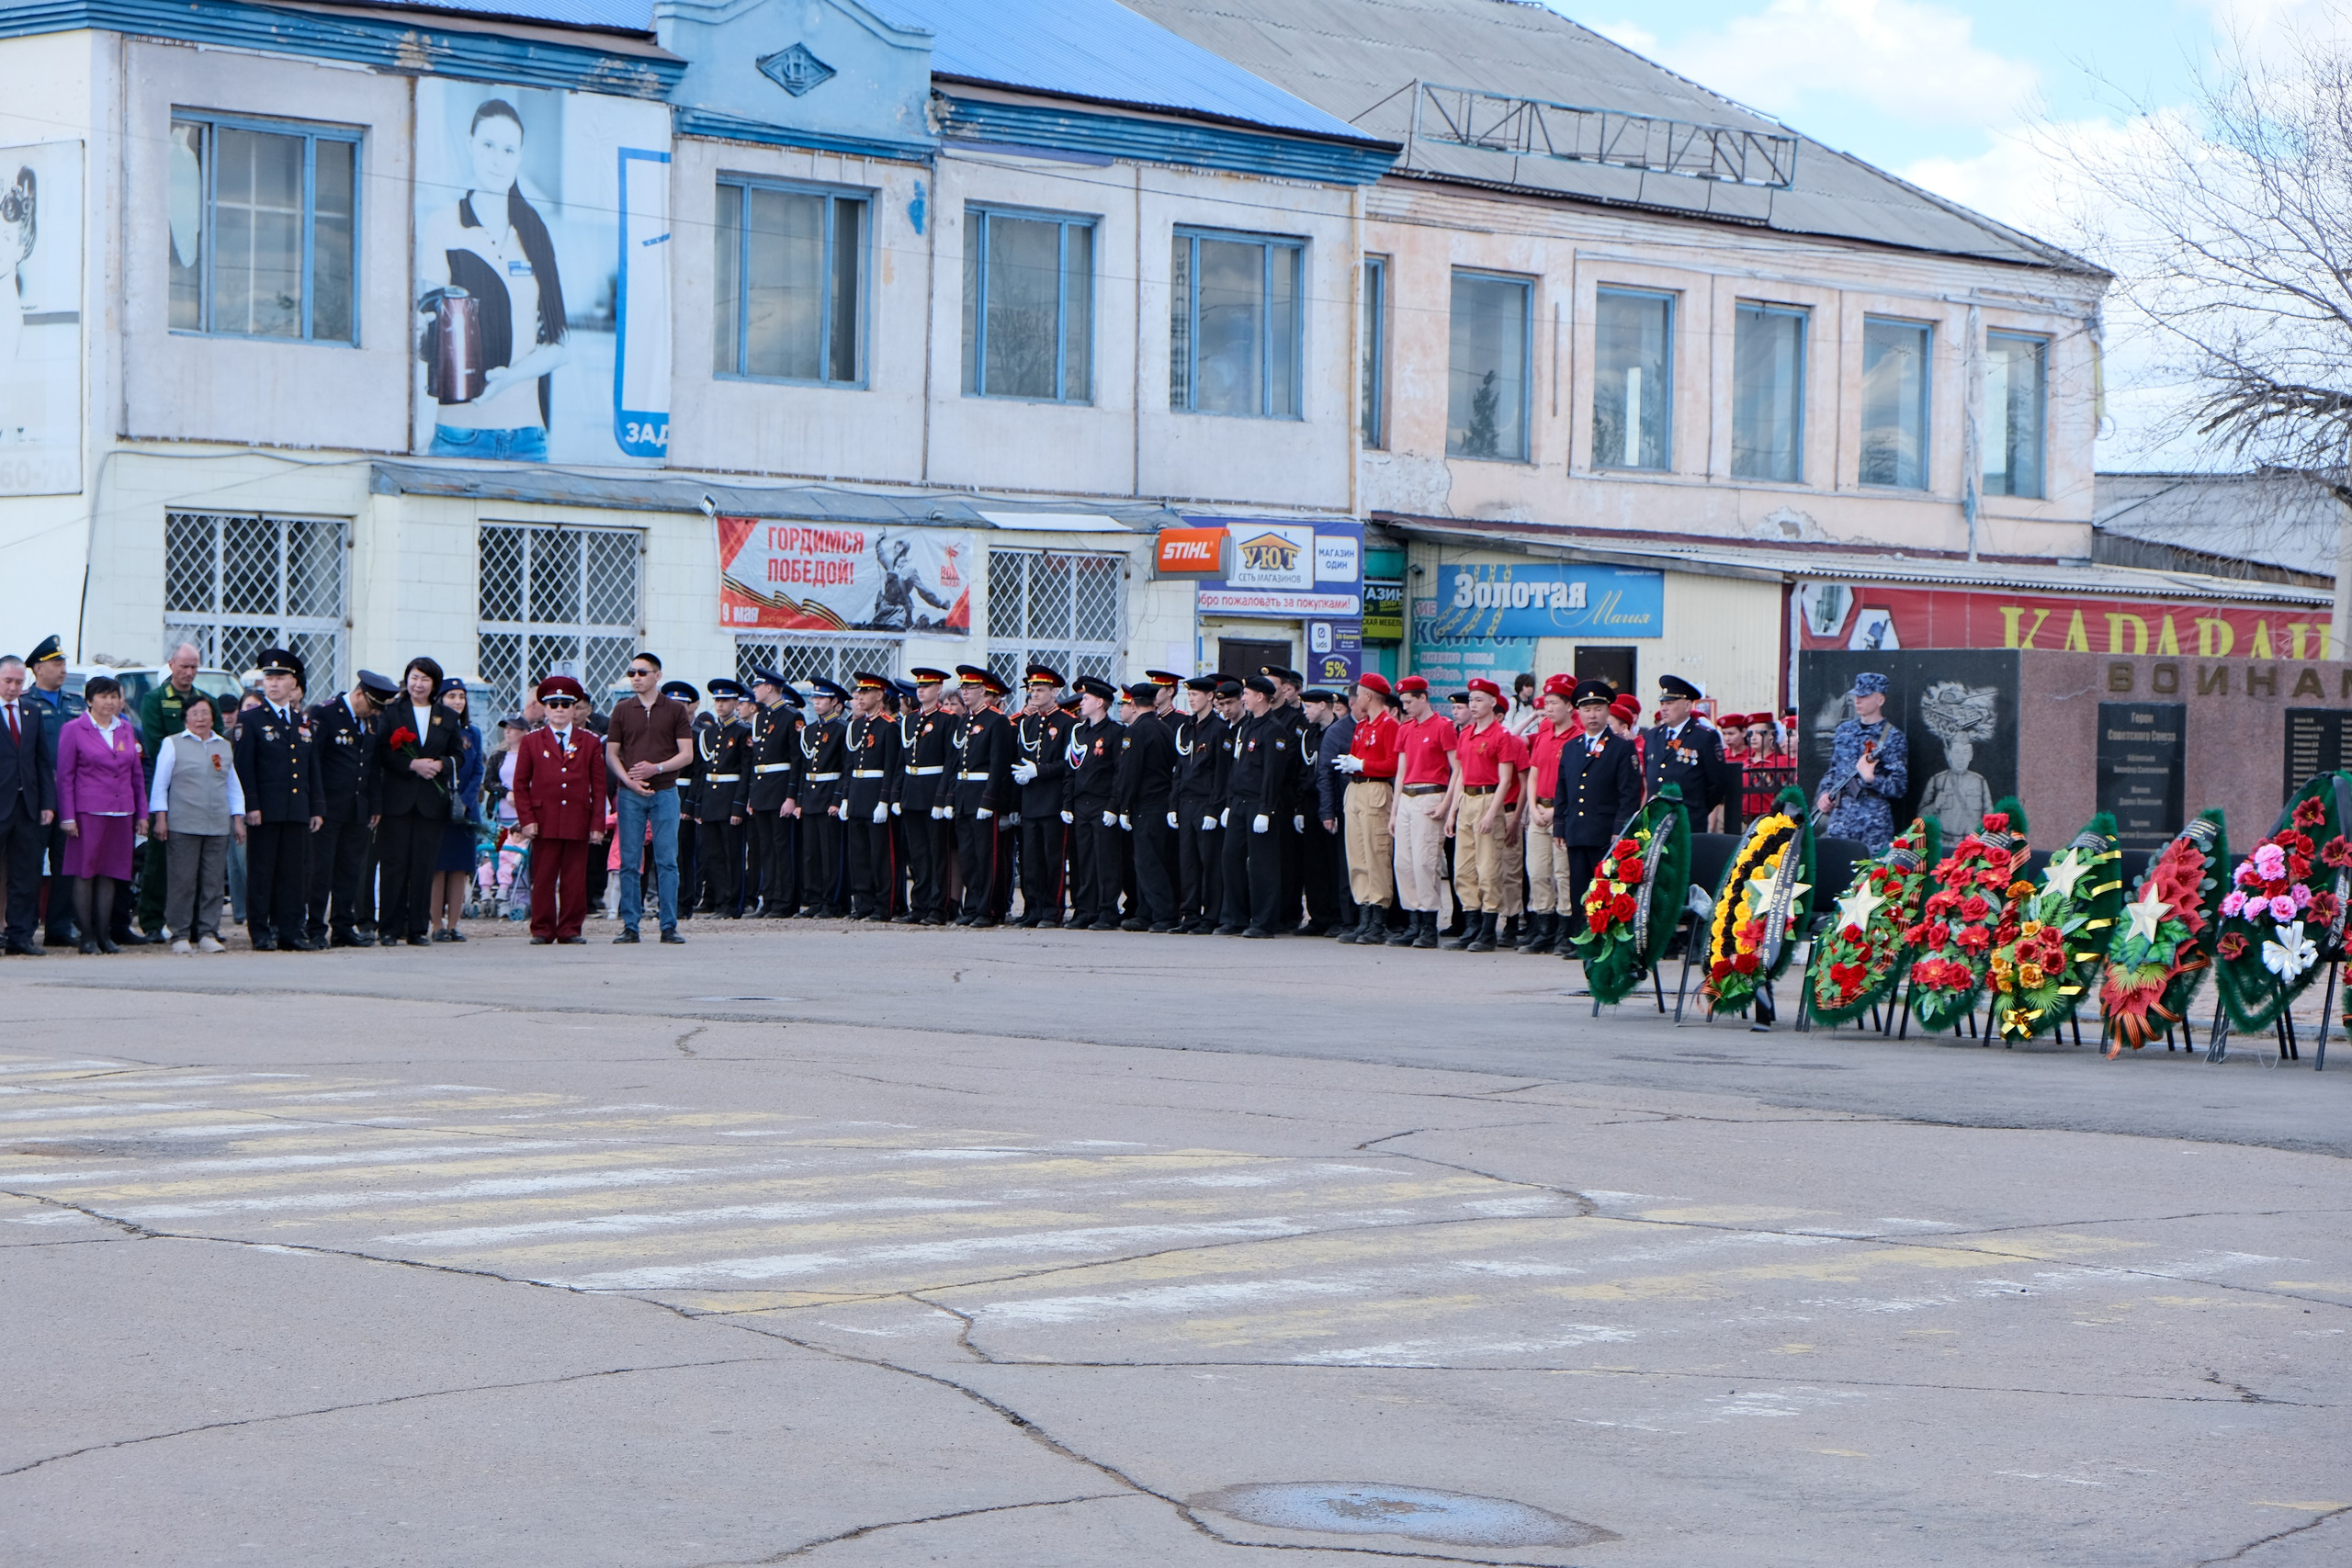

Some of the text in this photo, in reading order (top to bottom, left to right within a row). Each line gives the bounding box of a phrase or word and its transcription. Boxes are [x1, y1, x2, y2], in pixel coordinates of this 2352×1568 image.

[768, 527, 865, 556] ГОРДИМСЯ
[1162, 541, 1211, 559] STIHL
[1243, 546, 1298, 570] УЮТ
[1318, 548, 1355, 558] МАГАЗИН
[768, 558, 854, 588] ПОБЕДОЙ!
[1326, 560, 1348, 570] ОДИН
[1238, 573, 1302, 583] СЕТЬ МАГАЗИНОВ
[1363, 587, 1403, 601] АЗИН
[1453, 573, 1588, 610] Золотая
[1222, 596, 1281, 606] пожаловать
[1283, 598, 1294, 607] за
[1296, 598, 1351, 611] покупками!
[1569, 590, 1651, 627] Магия
[722, 603, 729, 622] 9
[733, 606, 760, 623] мая
[1464, 652, 1495, 664] цены
[1325, 661, 1347, 678] 5%
[1419, 667, 1463, 681] мебель
